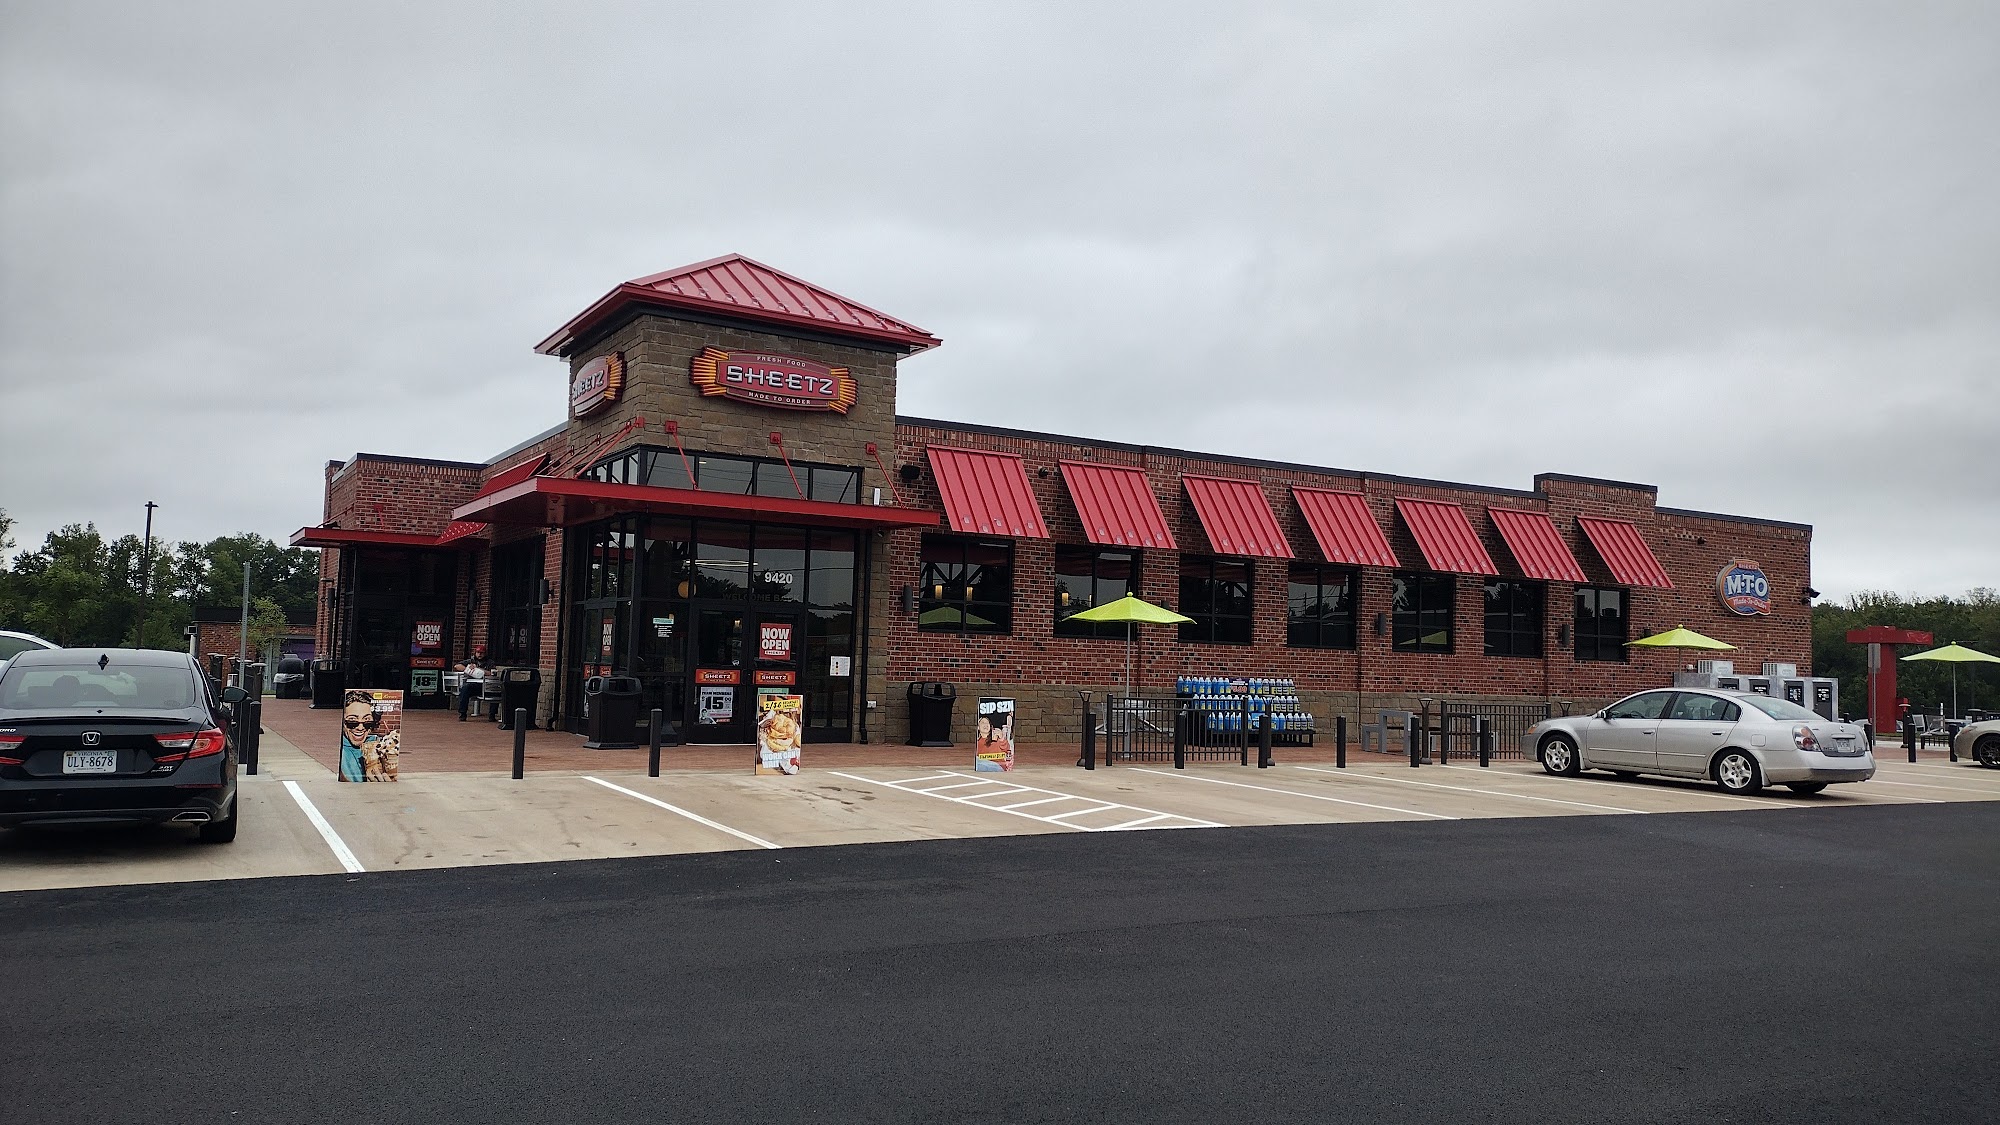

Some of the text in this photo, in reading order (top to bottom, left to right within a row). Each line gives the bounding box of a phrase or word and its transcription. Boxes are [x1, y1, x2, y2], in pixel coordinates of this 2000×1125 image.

[787, 359, 806, 368] FOOD
[726, 365, 834, 395] SHEETZ
[748, 391, 769, 400] MADE
[764, 571, 793, 584] 9420
[417, 624, 441, 634] NOW
[761, 627, 790, 640] NOW
[416, 633, 441, 642] OPEN
[761, 639, 790, 651] OPEN
[980, 700, 1015, 714] SIP SZN
[67, 755, 114, 768] ULY-8678
[762, 752, 782, 761] WORK
